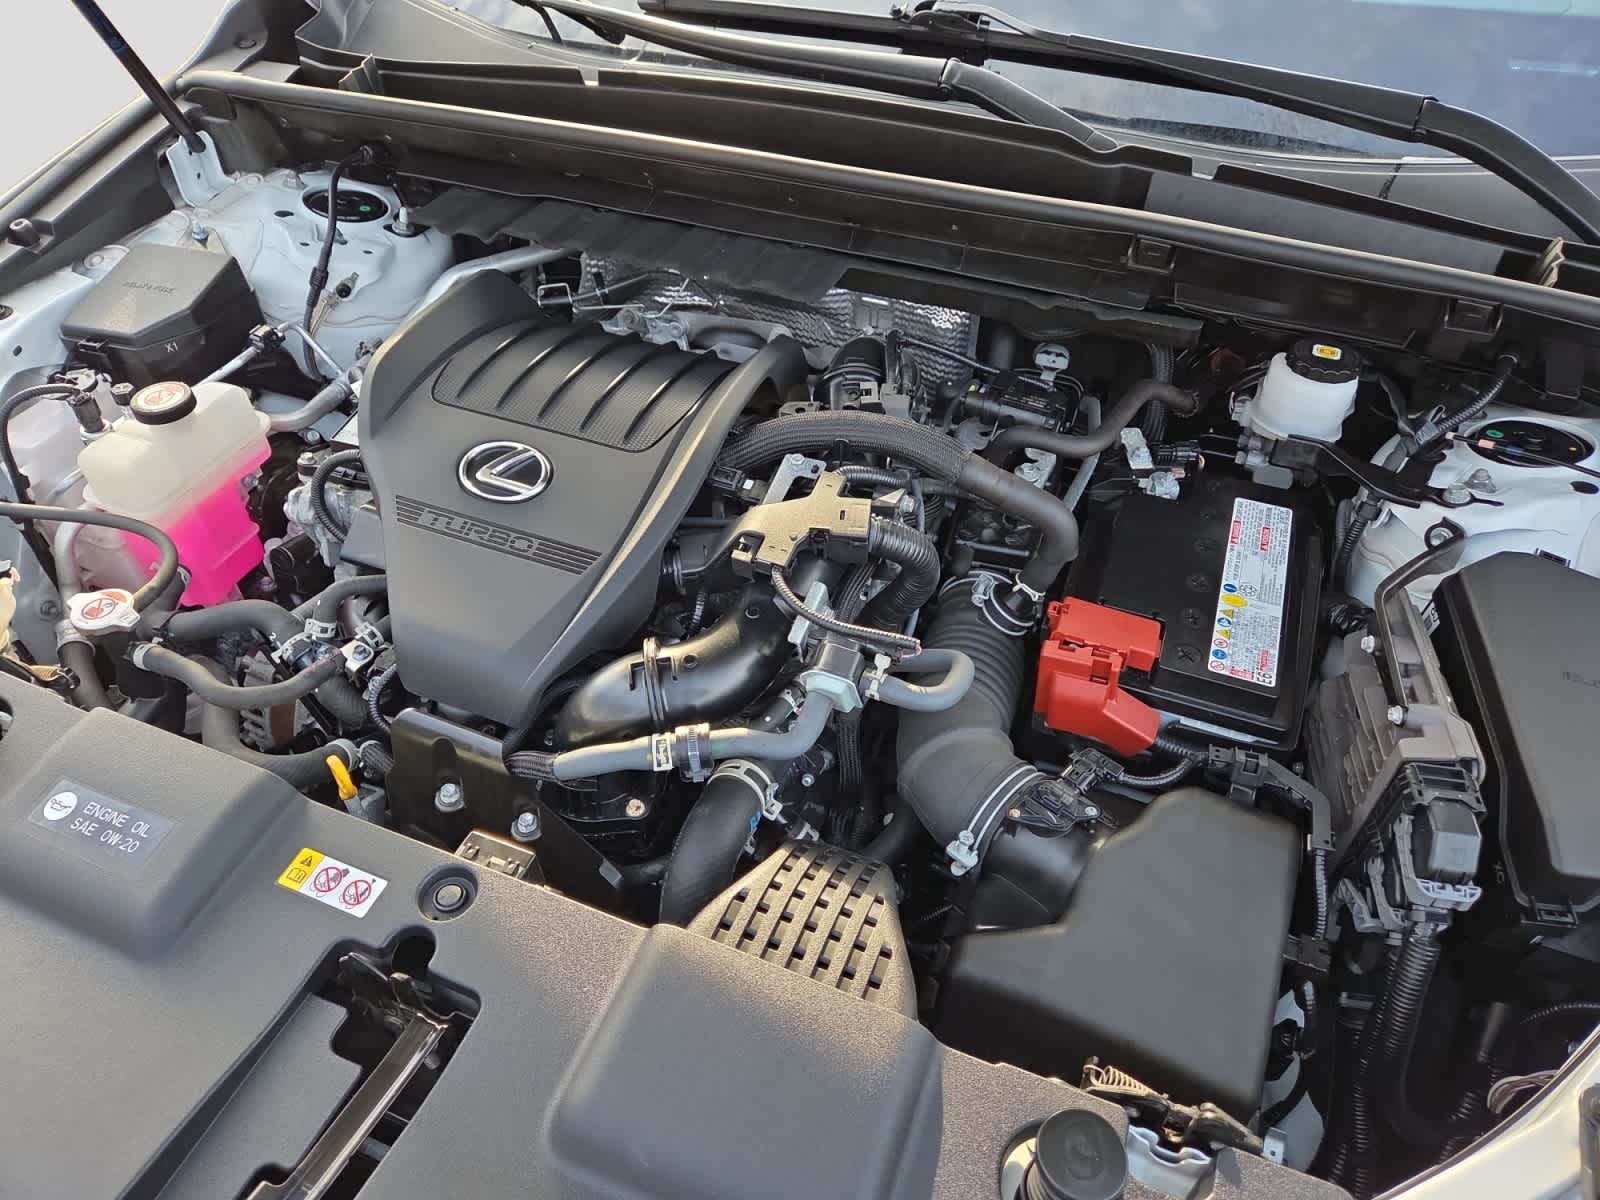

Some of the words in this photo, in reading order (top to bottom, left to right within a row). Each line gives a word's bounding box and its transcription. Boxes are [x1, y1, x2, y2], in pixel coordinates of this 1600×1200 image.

[426, 509, 536, 555] TURBO
[70, 817, 99, 836] SAE
[100, 829, 140, 853] 0W-20
[83, 801, 130, 828] ENGINE
[131, 821, 151, 838] OIL
